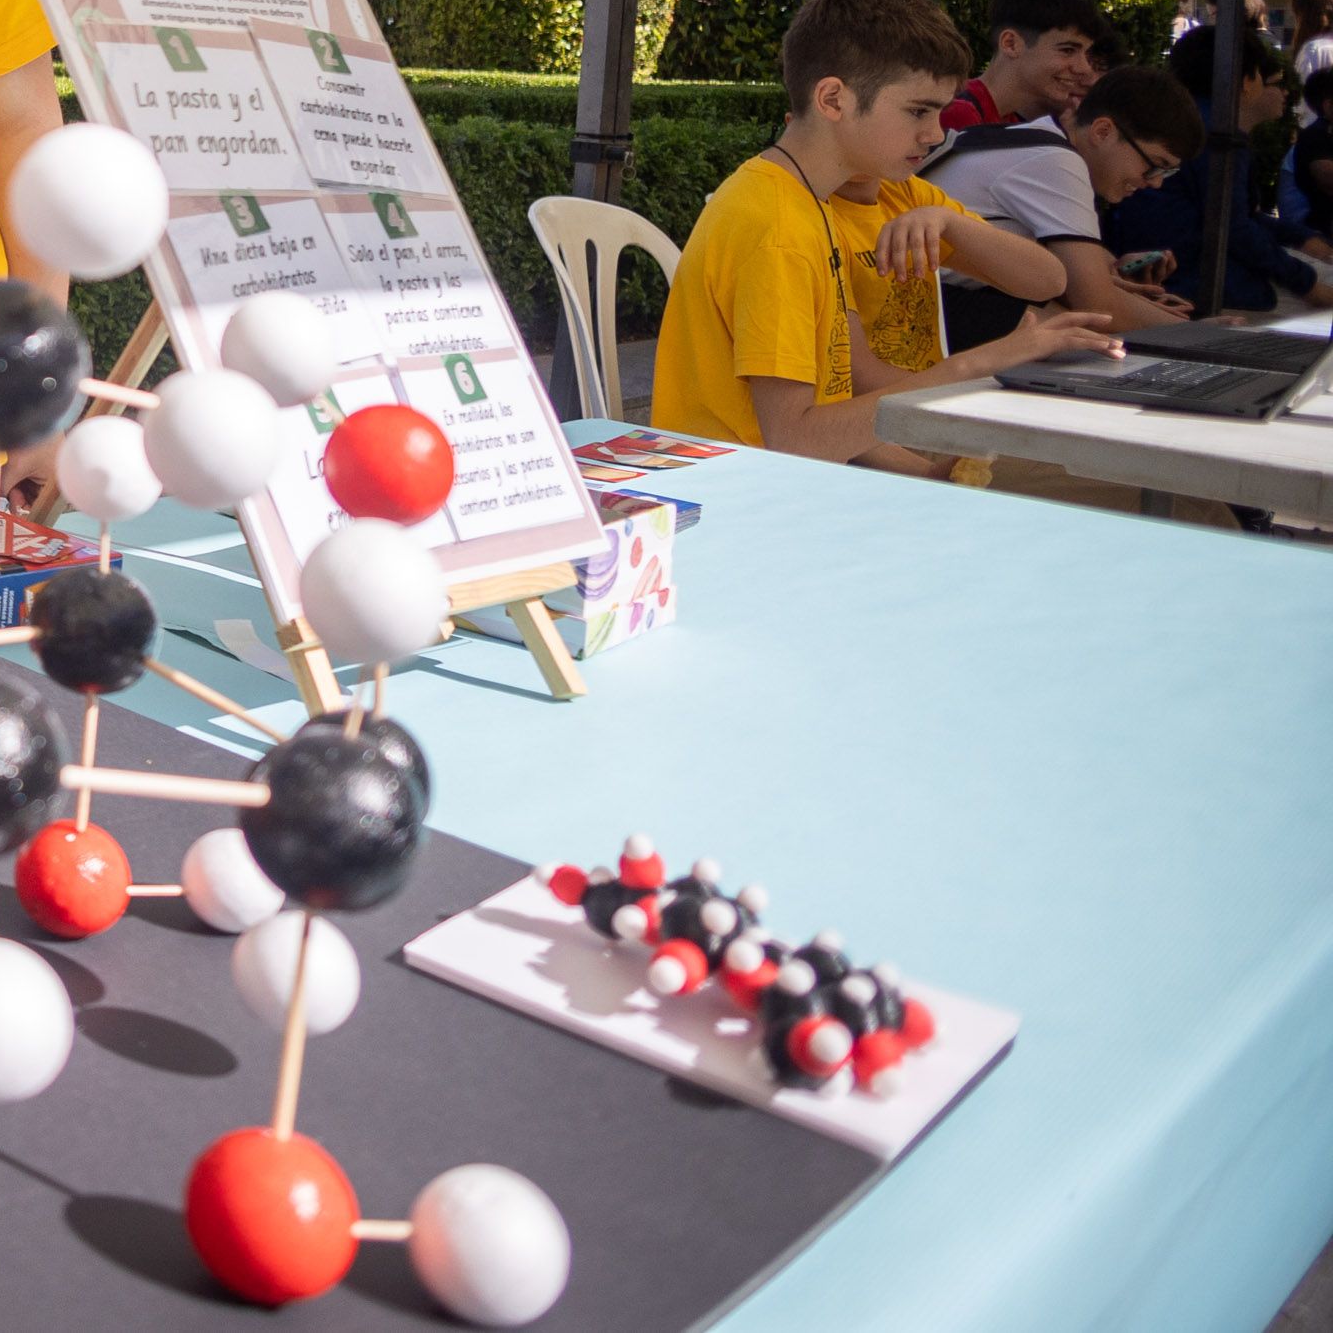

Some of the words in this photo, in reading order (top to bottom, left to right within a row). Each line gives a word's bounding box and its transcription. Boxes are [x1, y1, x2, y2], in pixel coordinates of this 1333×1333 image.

[168, 34, 191, 64] 1
[316, 37, 339, 66] 2
[317, 75, 366, 97] Consumir
[133, 82, 159, 108] La
[166, 88, 222, 120] pasta
[229, 93, 242, 122] y
[249, 87, 264, 111] el
[300, 99, 374, 123] carbohidratos
[377, 113, 390, 125] en
[391, 112, 405, 128] la
[150, 133, 188, 165] pan
[197, 129, 288, 167] engordan.
[314, 128, 339, 143] cena
[342, 132, 374, 151] puede
[376, 133, 414, 154] hacerle
[230, 196, 256, 229] 3
[388, 202, 406, 232] 4
[200, 247, 230, 268] Una
[234, 242, 267, 262] dieta
[268, 234, 299, 261] baja
[302, 236, 317, 250] en
[347, 244, 375, 263] Solo
[379, 243, 389, 261] el
[393, 246, 421, 269] pan,
[422, 242, 432, 259] el
[436, 245, 469, 261] arroz,
[232, 269, 318, 298] carbohidratos
[379, 274, 393, 292] la
[397, 275, 430, 300] pasta
[433, 276, 443, 299] y
[444, 271, 462, 288] las
[385, 309, 429, 333] patatas
[434, 305, 483, 321] contienen
[408, 335, 489, 356] carbohidratos.
[454, 361, 475, 395] 6
[451, 435, 504, 456] rbohidratos
[520, 430, 536, 444] son
[454, 468, 492, 486] cesarios
